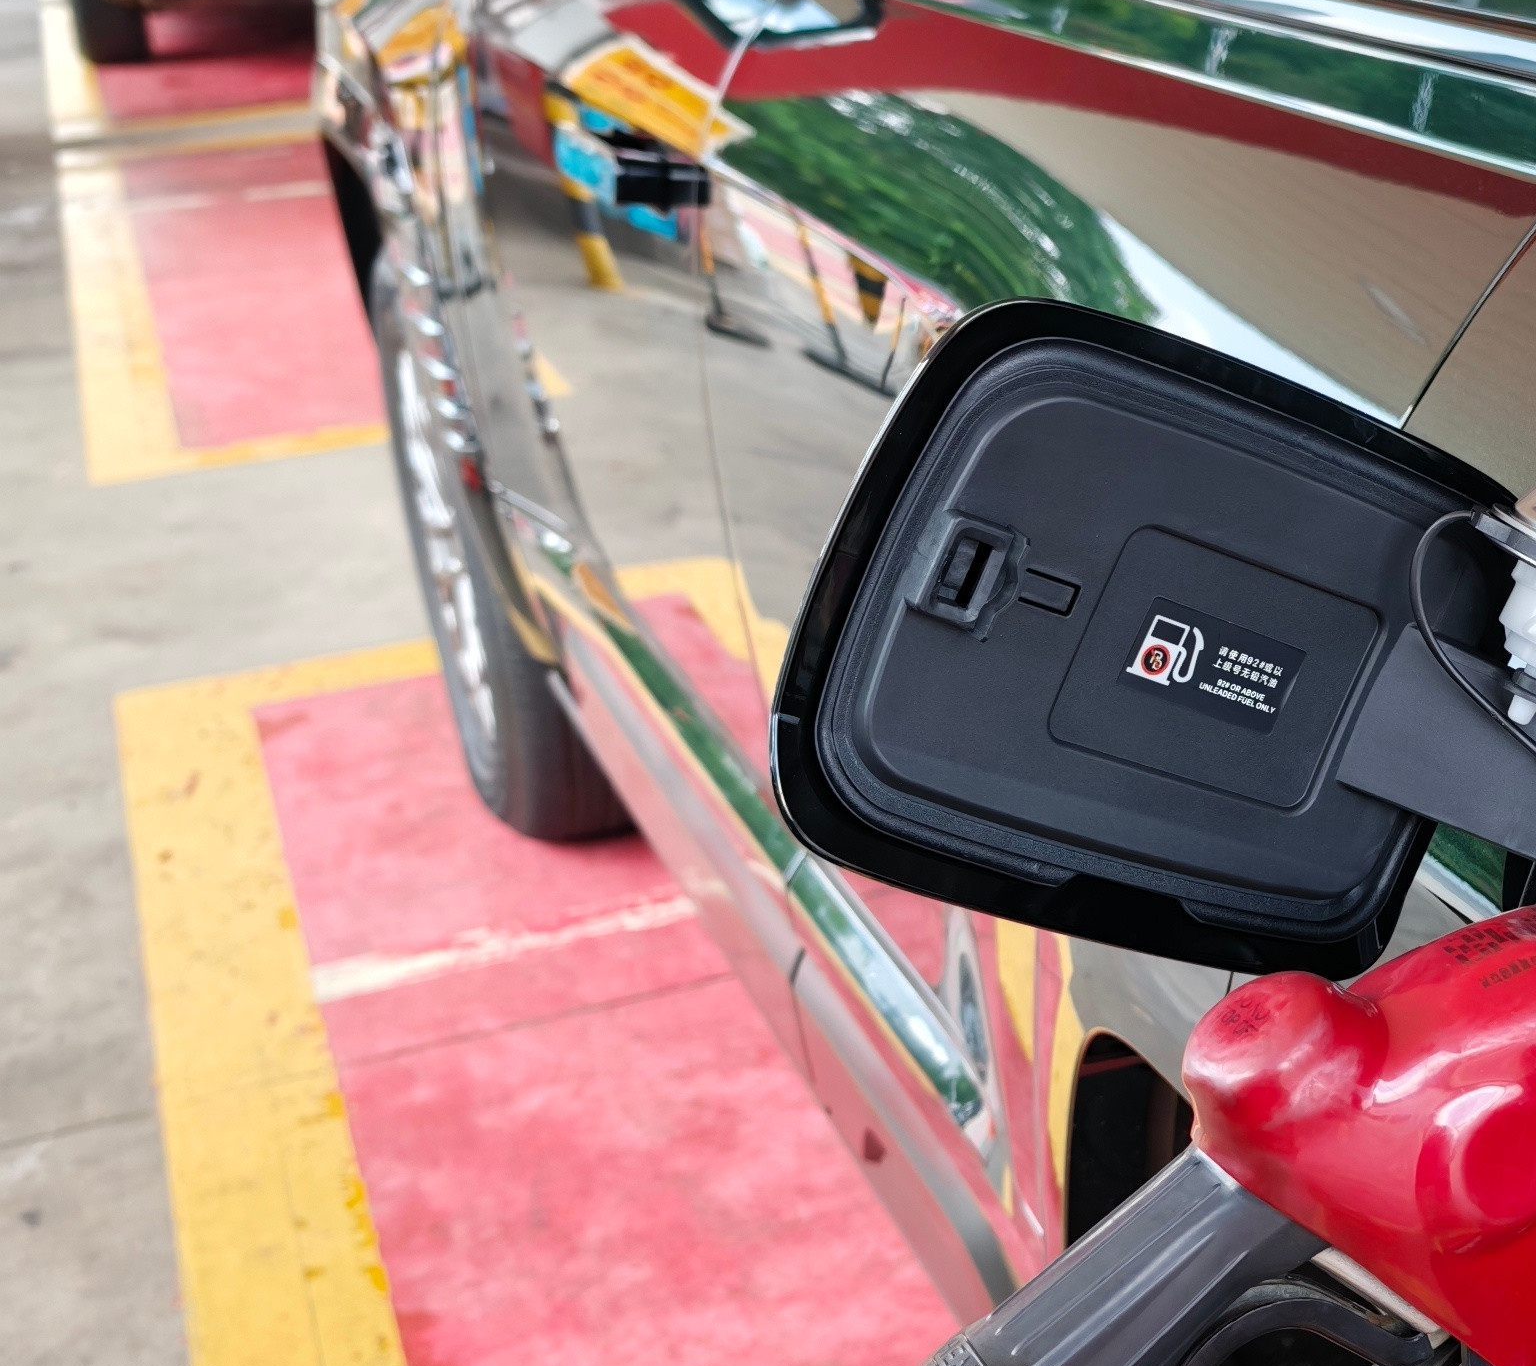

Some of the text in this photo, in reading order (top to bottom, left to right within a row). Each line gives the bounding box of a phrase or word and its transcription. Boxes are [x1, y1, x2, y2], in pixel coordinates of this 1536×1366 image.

[1199, 682, 1276, 714] UNLEADED FUEL ONLY
[1229, 683, 1242, 693] OR
[1241, 688, 1265, 701] ABOVE
